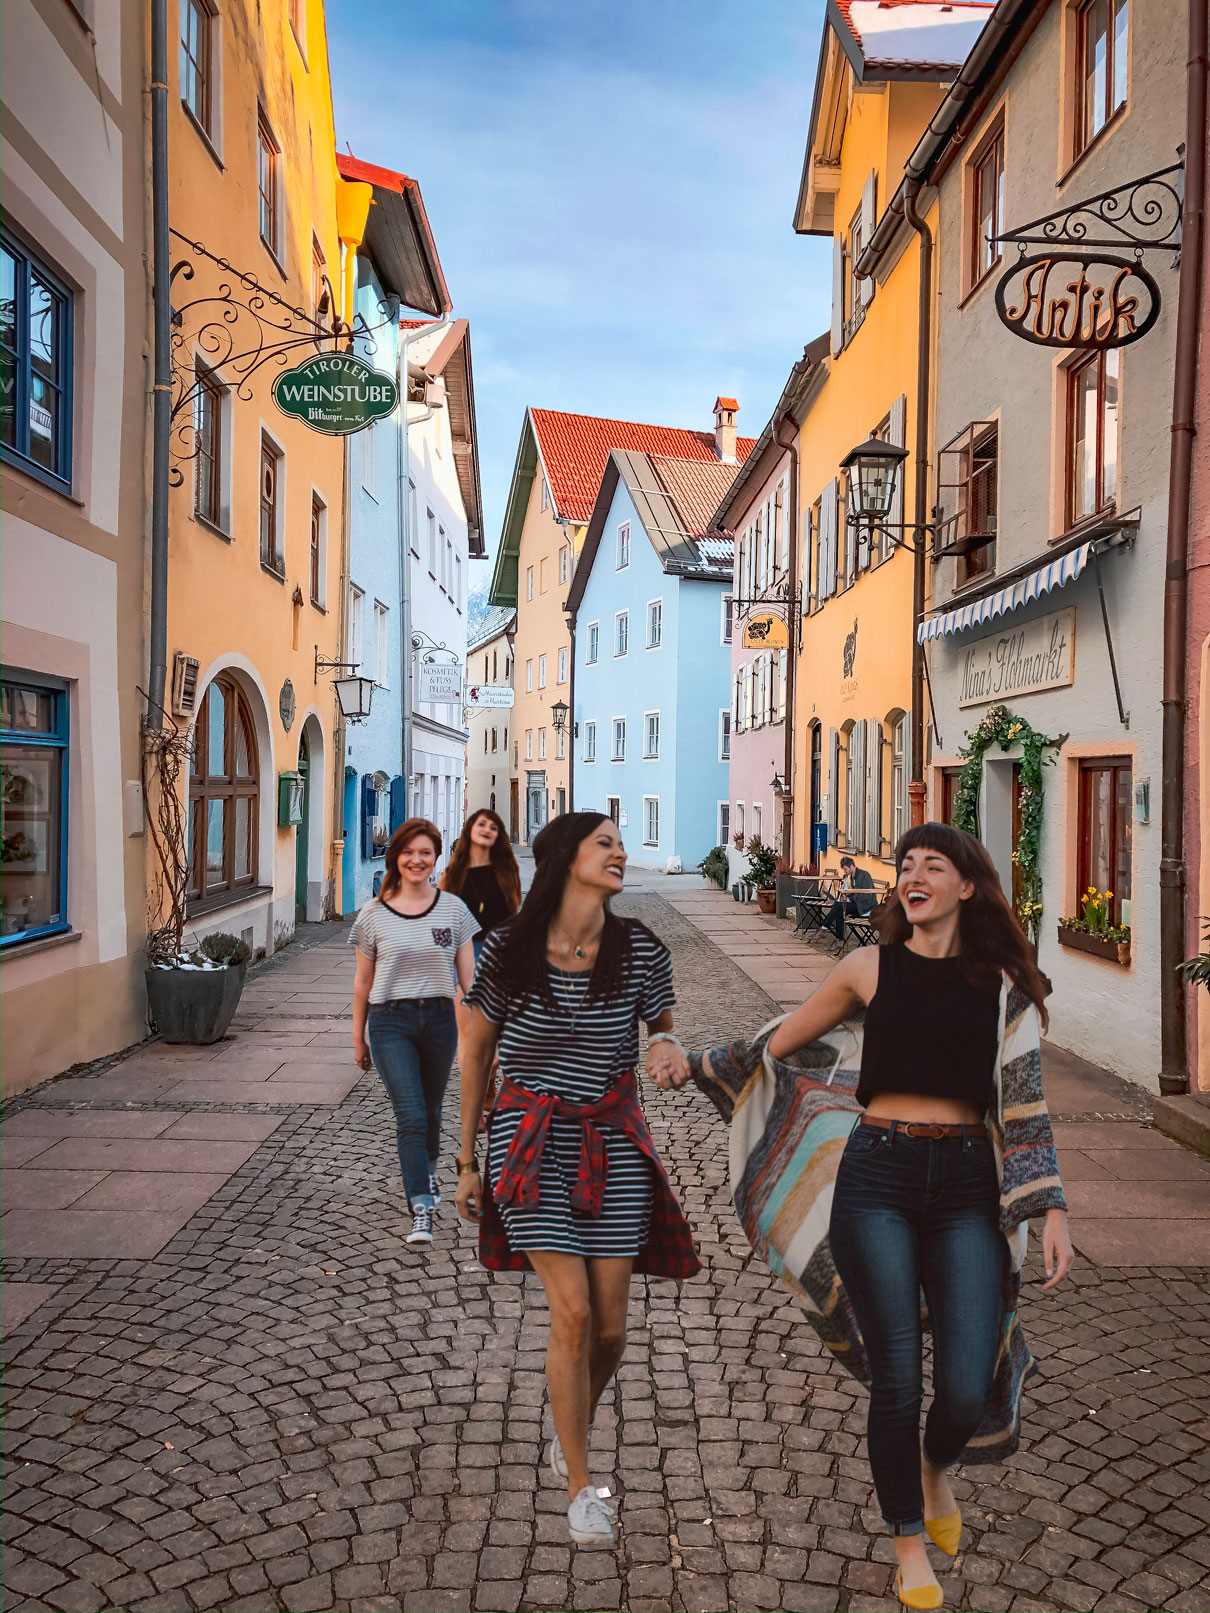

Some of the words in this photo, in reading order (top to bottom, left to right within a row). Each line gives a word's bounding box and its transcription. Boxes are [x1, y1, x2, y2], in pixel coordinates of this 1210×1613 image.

[1006, 259, 1139, 341] Antik
[303, 359, 369, 383] TIROLER
[282, 385, 391, 402] WEINSTUBE
[959, 648, 992, 702] Nina's
[993, 619, 1067, 694] Flohmarkt
[423, 667, 459, 676] KOSMETIK
[429, 685, 452, 694] PFLEGE
[436, 677, 452, 685] FUSS
